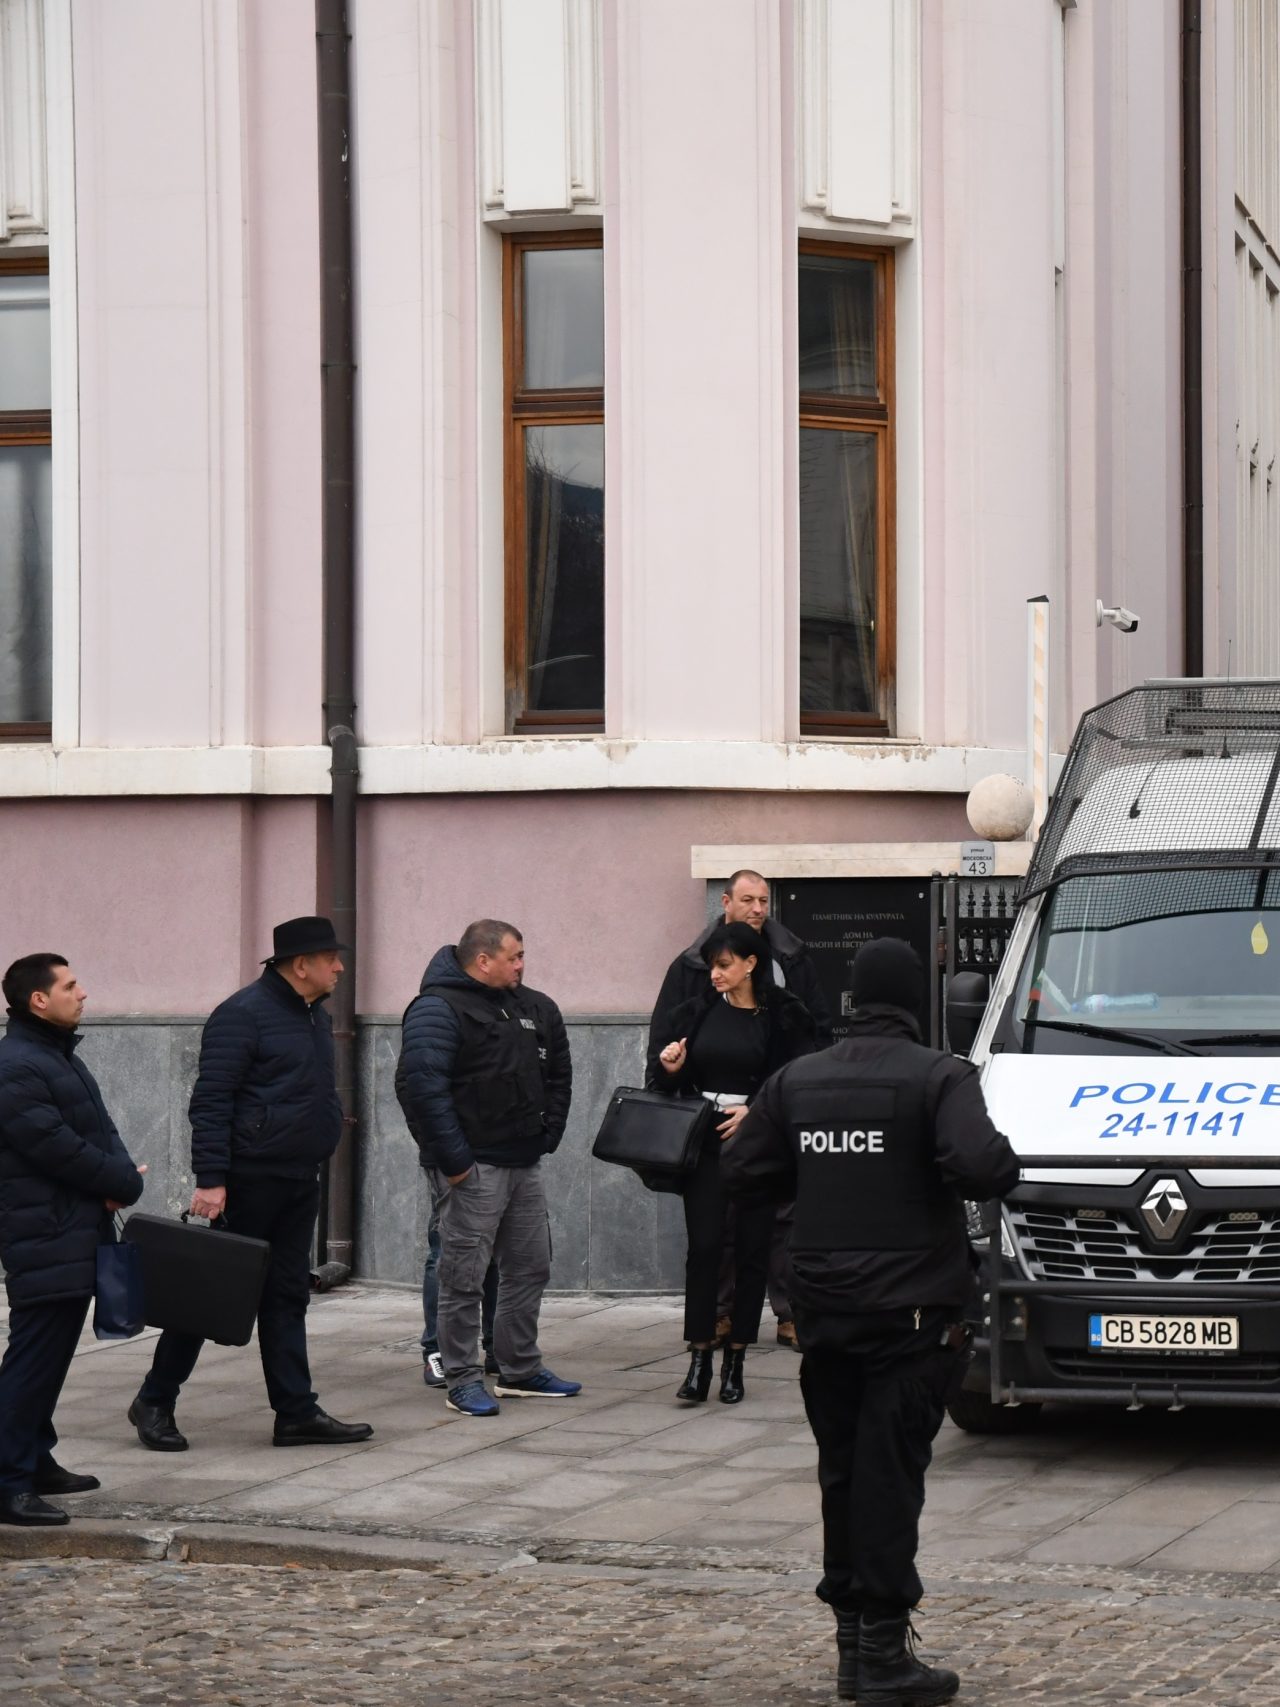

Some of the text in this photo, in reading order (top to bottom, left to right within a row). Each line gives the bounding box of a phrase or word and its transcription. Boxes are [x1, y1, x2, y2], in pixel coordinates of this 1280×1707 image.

[968, 861, 987, 875] 43
[843, 931, 861, 939] ДОМ
[1099, 1111, 1245, 1138] 24-1141
[800, 1131, 884, 1153] POLICE
[1105, 1320, 1232, 1345] CB 5828 MB
